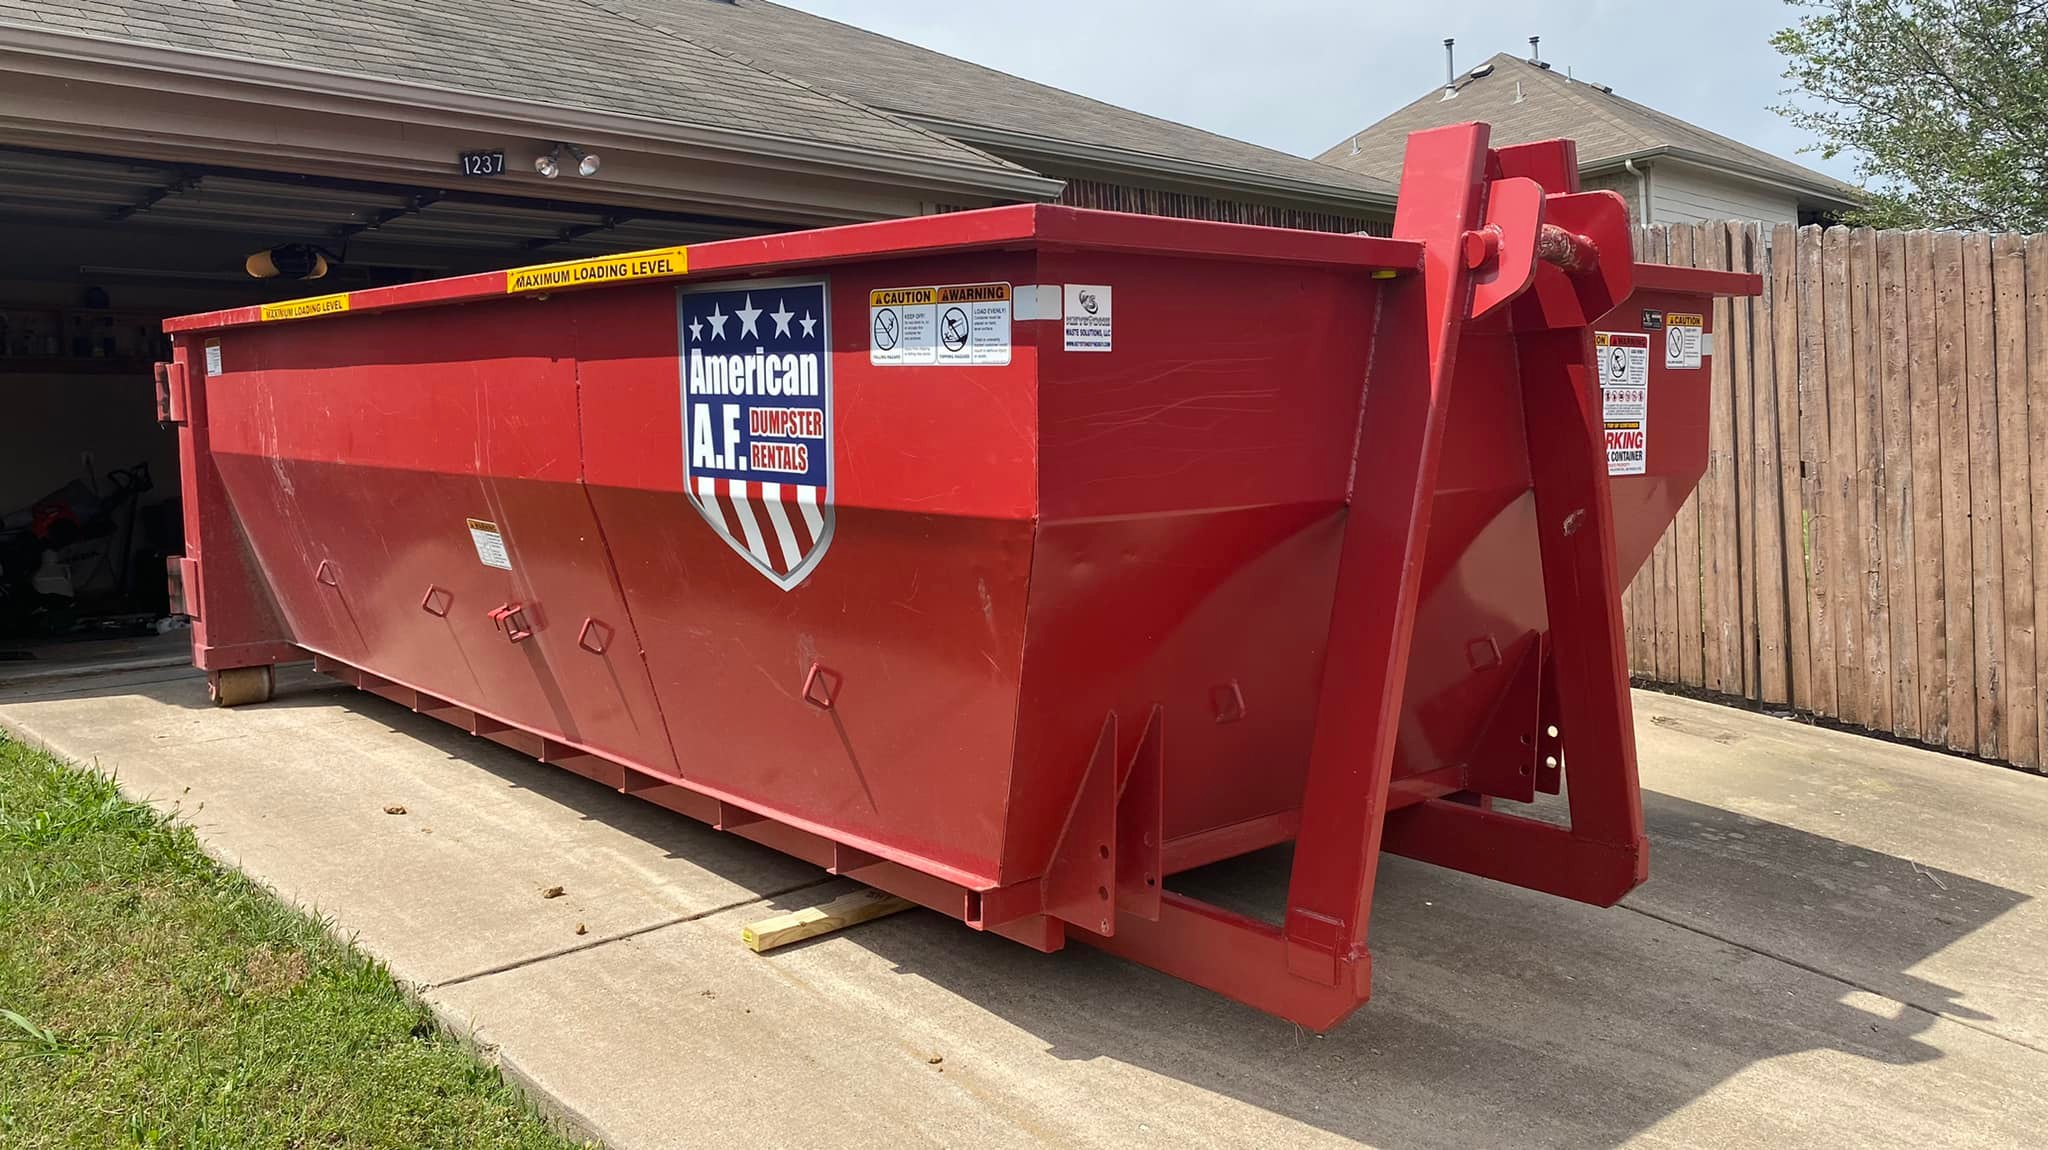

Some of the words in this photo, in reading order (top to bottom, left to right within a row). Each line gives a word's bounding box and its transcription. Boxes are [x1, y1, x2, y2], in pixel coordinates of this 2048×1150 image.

[464, 154, 503, 175] 1237
[516, 270, 570, 289] MAXIMUM
[574, 263, 628, 281] LOADING
[631, 259, 674, 276] LEVEL
[883, 290, 931, 304] CAUTION
[948, 286, 1004, 301] WARNING
[294, 303, 321, 317] LOADING
[322, 300, 343, 312] LEVEL
[1675, 315, 1701, 324] CAUTION
[1066, 328, 1079, 336] WASTE
[1596, 335, 1606, 345] ON
[689, 346, 819, 396] American
[692, 403, 748, 471] A.F.
[750, 408, 823, 437] DUMPSTER
[1605, 431, 1643, 450] RKING
[751, 443, 807, 472] RENTALS
[1610, 450, 1643, 462] CONTAINER
